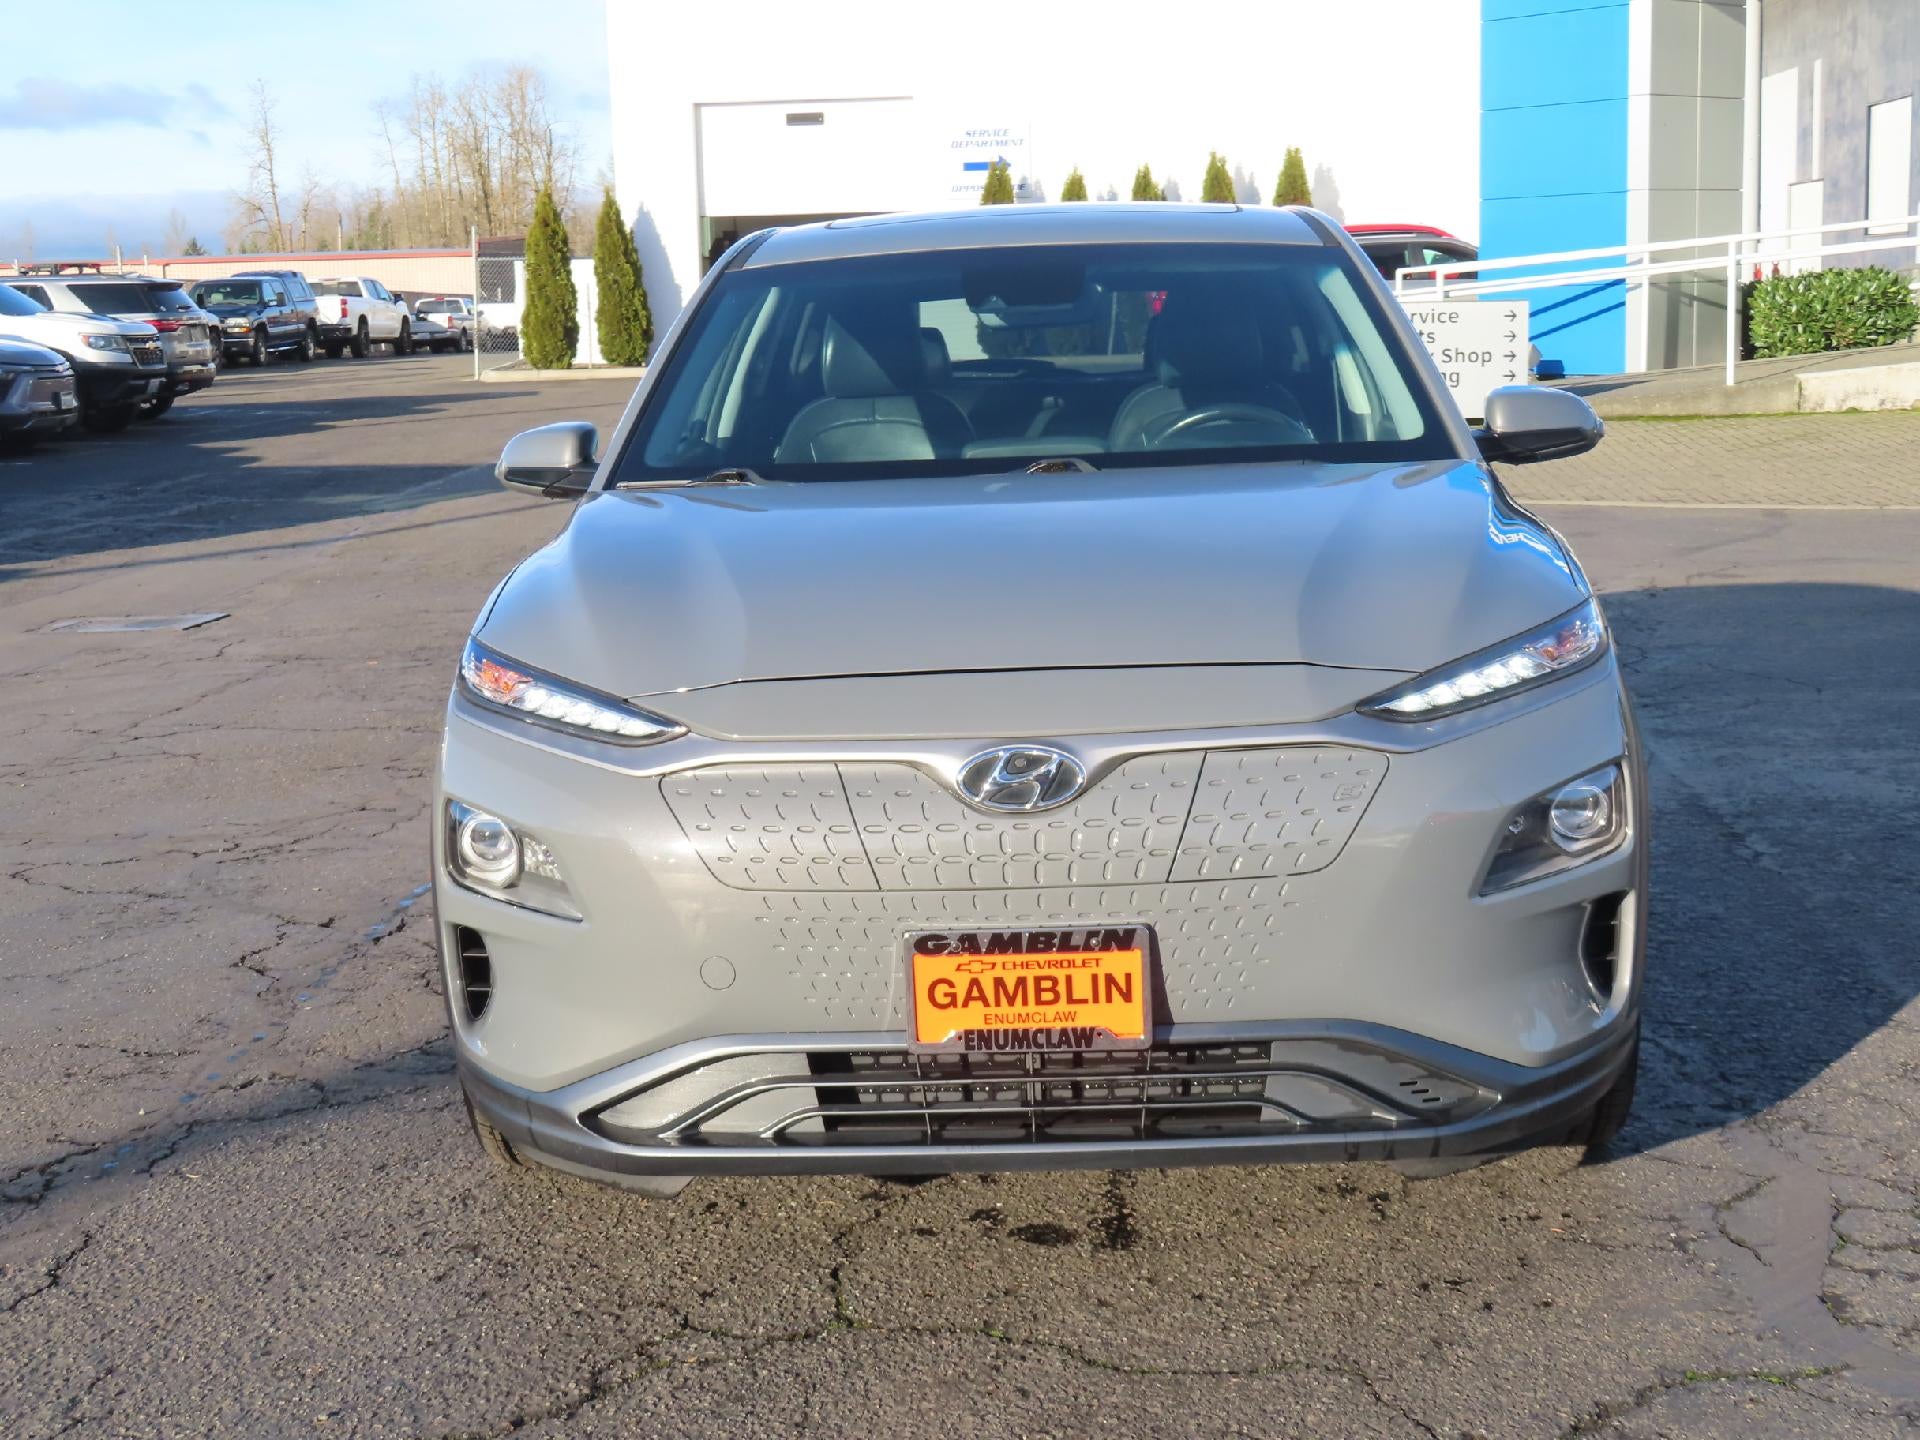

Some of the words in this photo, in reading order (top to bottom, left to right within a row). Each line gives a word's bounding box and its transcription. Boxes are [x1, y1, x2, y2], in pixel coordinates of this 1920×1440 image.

[966, 128, 1009, 138] SERVICE
[951, 139, 1024, 149] DEPARTMENT
[1410, 308, 1460, 324] rvice
[1441, 348, 1492, 366] Shop
[913, 928, 1137, 956] GAMBLIN
[1002, 958, 1103, 970] CHEVROLET
[927, 972, 1134, 1010] GAMBLIN
[984, 1011, 1078, 1025] ENUMCLAW
[964, 1027, 1096, 1051] ENUMCLAW
